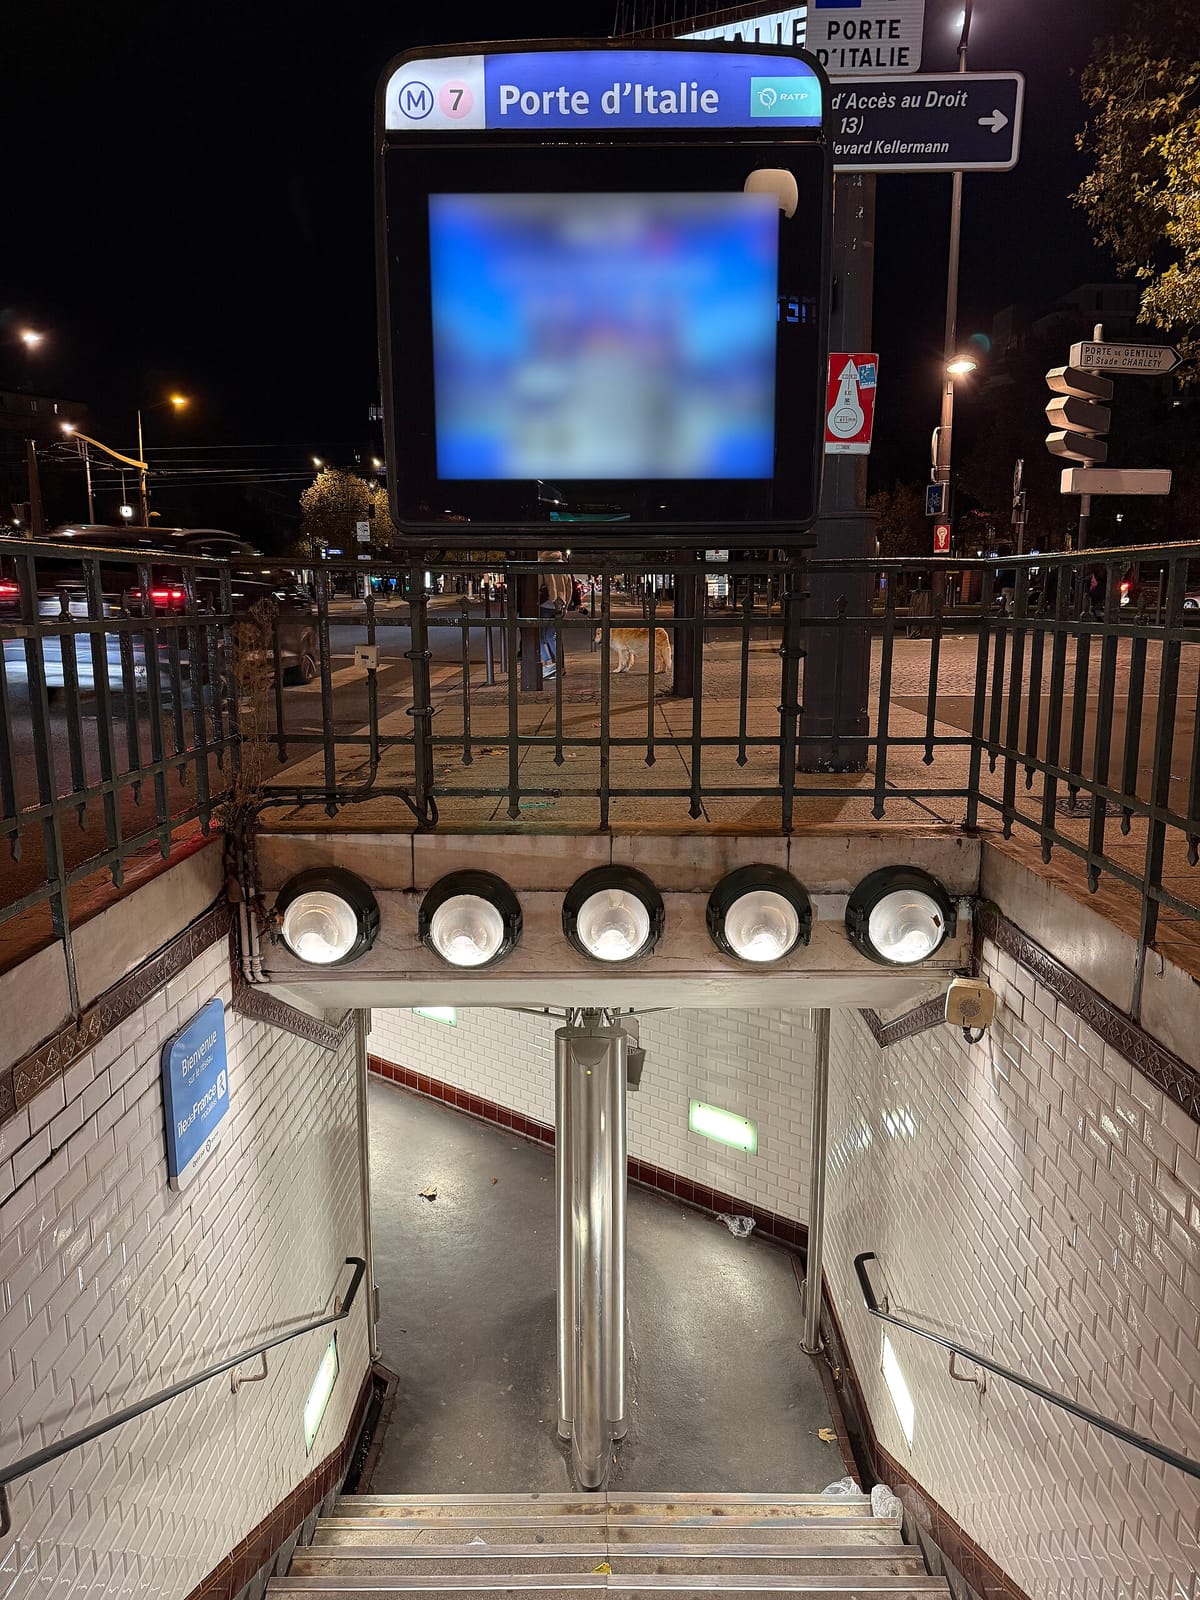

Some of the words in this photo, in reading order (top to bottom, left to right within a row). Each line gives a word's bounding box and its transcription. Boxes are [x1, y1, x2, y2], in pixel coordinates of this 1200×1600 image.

[827, 19, 901, 40] PORTE
[816, 47, 910, 68] D'ITALIE
[406, 89, 426, 112] M
[449, 88, 464, 111] 7
[500, 85, 590, 115] Porte
[601, 82, 719, 115] d'Italie
[779, 92, 808, 101] RATP
[831, 91, 896, 110] d'Accès
[901, 98, 921, 109] au
[925, 90, 968, 108] Droit
[840, 115, 864, 135] 13)
[832, 141, 872, 155] levard
[874, 140, 949, 154] Kellermann
[1085, 346, 1112, 356] PORTE
[1124, 349, 1163, 358] GENTILLY
[1095, 356, 1119, 365] Stade
[1121, 358, 1163, 367] CHARLETY
[181, 1030, 217, 1078] Bienvenue
